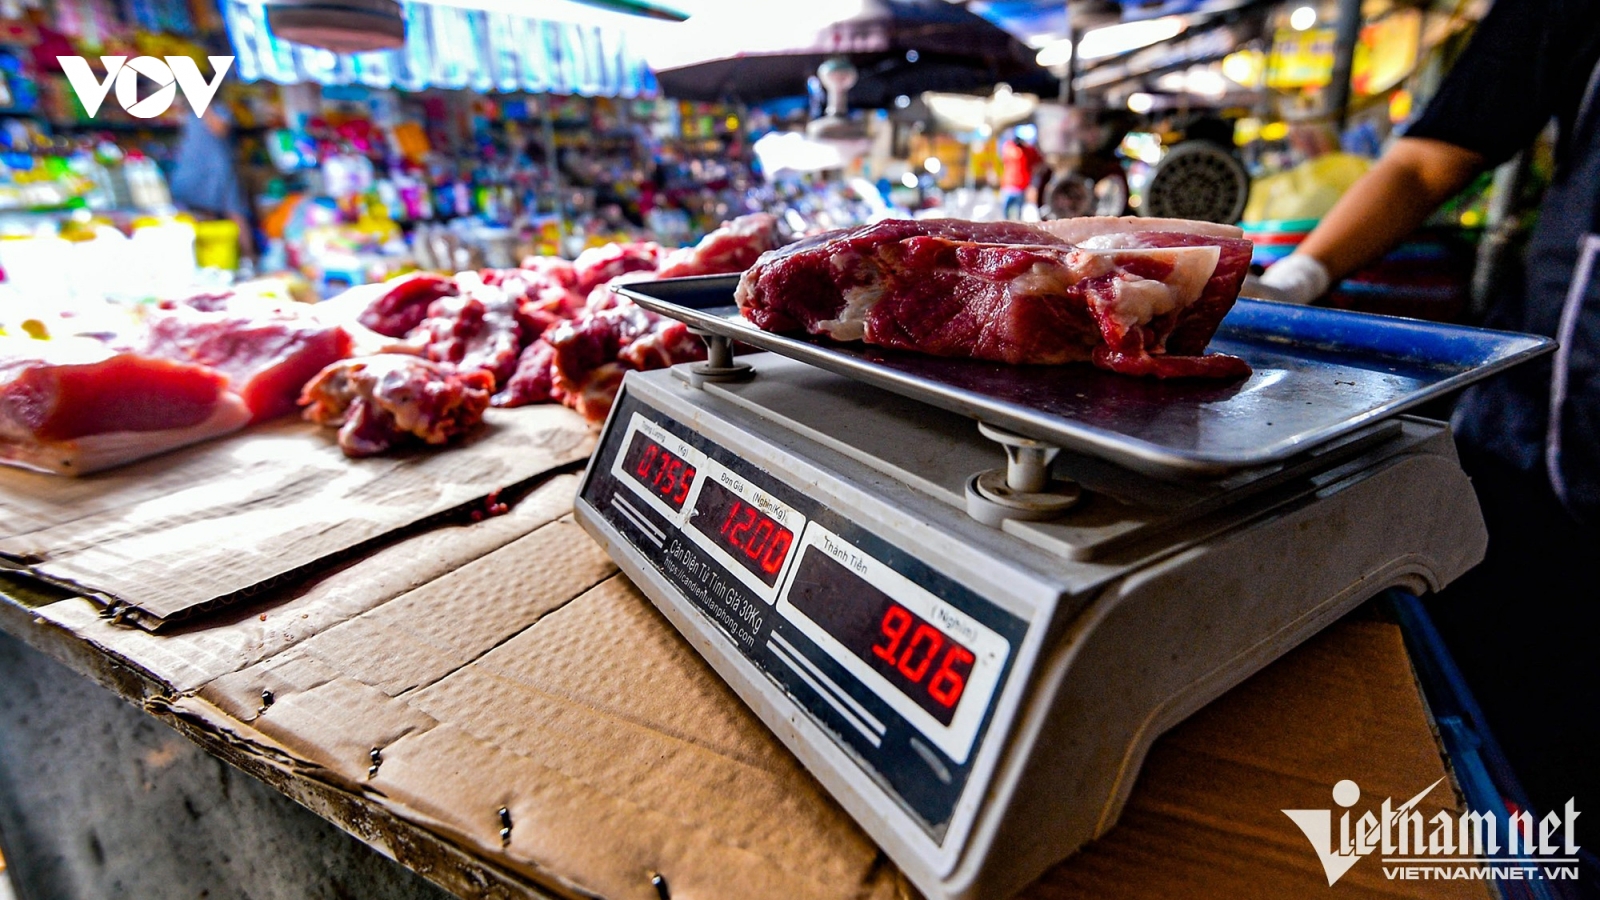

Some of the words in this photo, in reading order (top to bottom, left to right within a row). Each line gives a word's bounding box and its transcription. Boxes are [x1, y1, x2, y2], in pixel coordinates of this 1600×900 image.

[678, 445, 689, 457] (Kg)
[720, 472, 733, 486] Đơn
[733, 480, 744, 492] Giá
[823, 537, 849, 562] Thành
[664, 556, 755, 647] https://candientutanphong.com
[670, 539, 684, 561] Cân
[682, 550, 699, 574] Điện
[708, 572, 726, 599] Tính
[739, 599, 763, 635] 30Kg
[872, 605, 976, 708] 9.06
